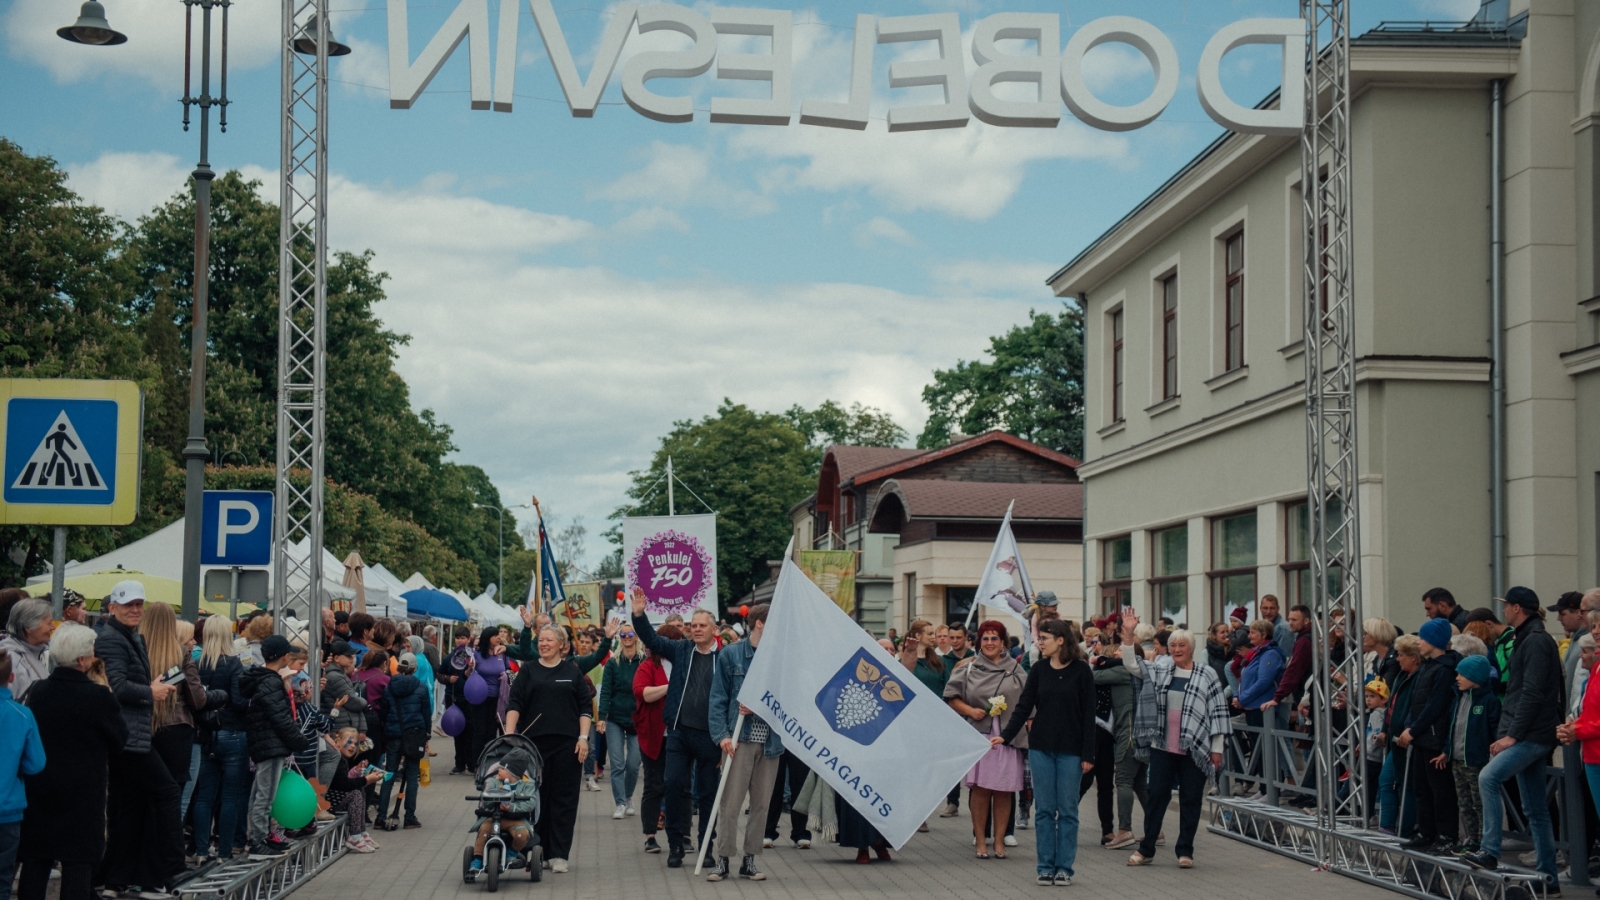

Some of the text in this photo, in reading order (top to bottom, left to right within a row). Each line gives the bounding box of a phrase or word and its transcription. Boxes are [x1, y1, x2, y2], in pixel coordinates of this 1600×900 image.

[217, 500, 259, 557] P
[647, 550, 693, 567] Penkulei
[650, 565, 693, 589] 750
[816, 746, 892, 817] PAGASTS
